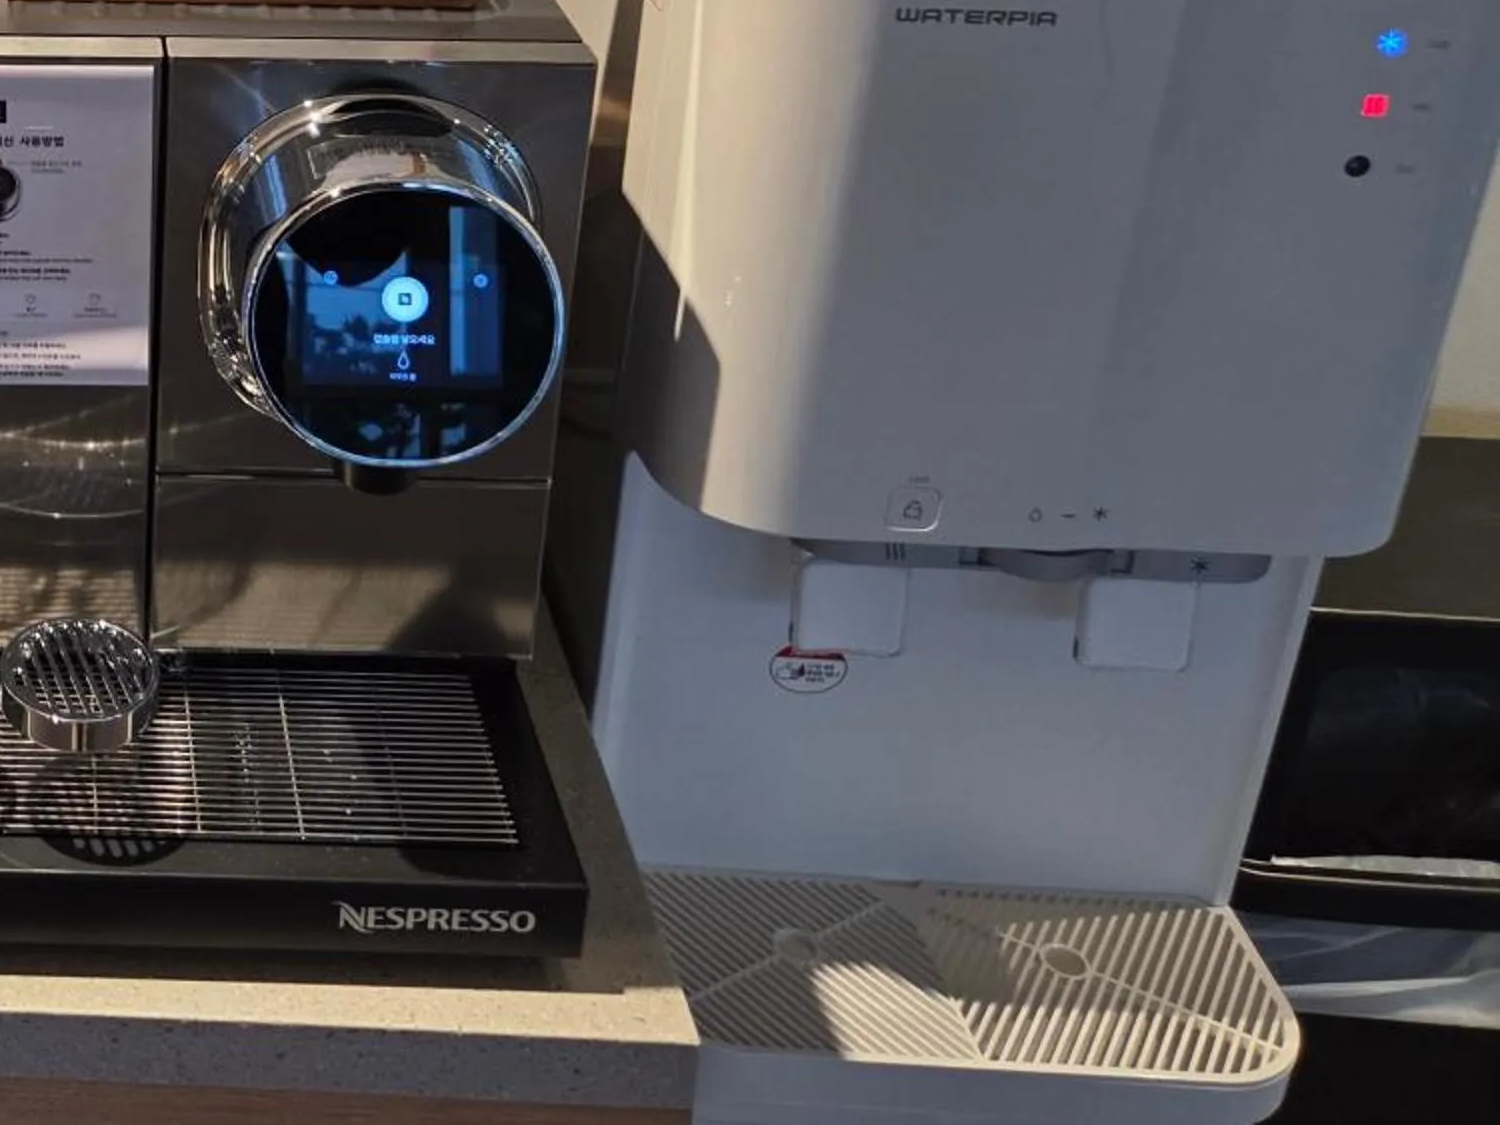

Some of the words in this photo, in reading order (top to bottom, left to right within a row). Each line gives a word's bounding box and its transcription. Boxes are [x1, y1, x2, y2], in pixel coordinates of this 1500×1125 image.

[896, 7, 1058, 28] WATERPIA
[19, 135, 65, 147] 사용방법
[333, 900, 536, 934] NESPRESSO
